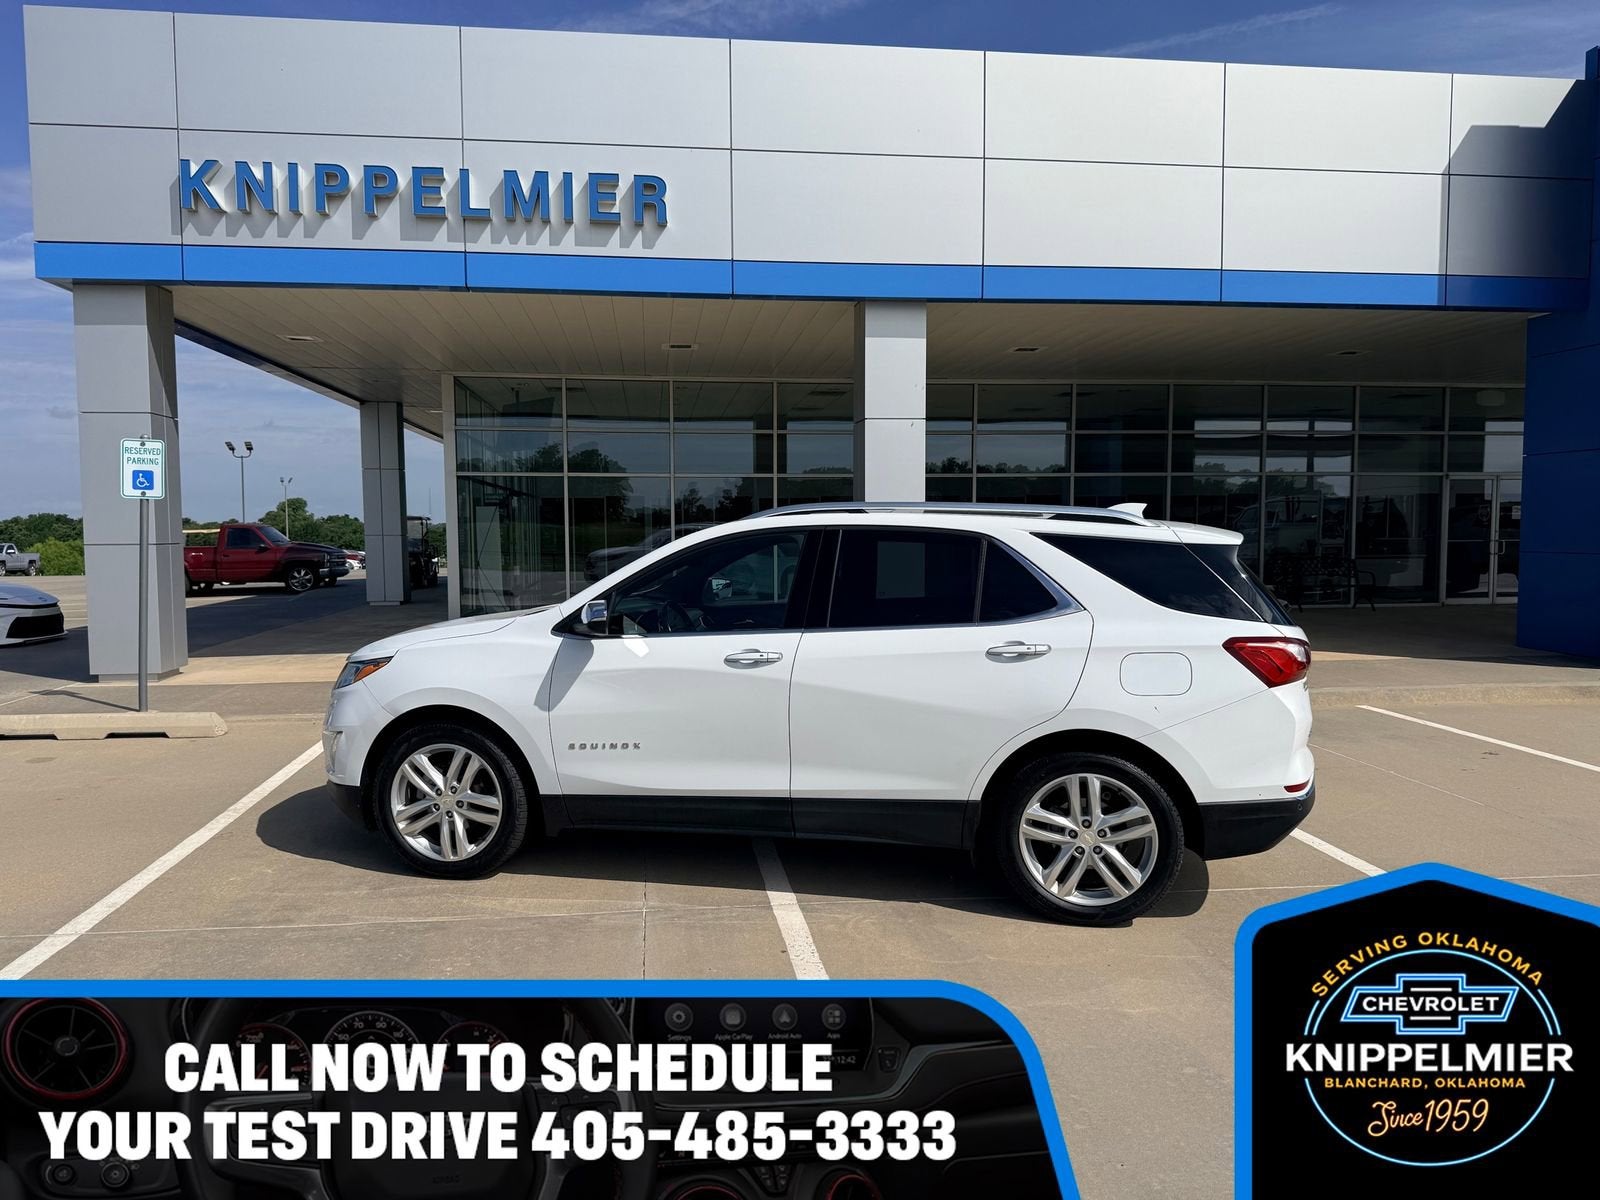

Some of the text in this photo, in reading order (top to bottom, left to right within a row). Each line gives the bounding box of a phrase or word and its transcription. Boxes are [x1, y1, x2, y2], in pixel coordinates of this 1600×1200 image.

[179, 158, 668, 226] KNIPPELMIER
[124, 446, 161, 456] RESERVED
[127, 456, 159, 465] PARKING
[568, 742, 641, 750] EQUINOX
